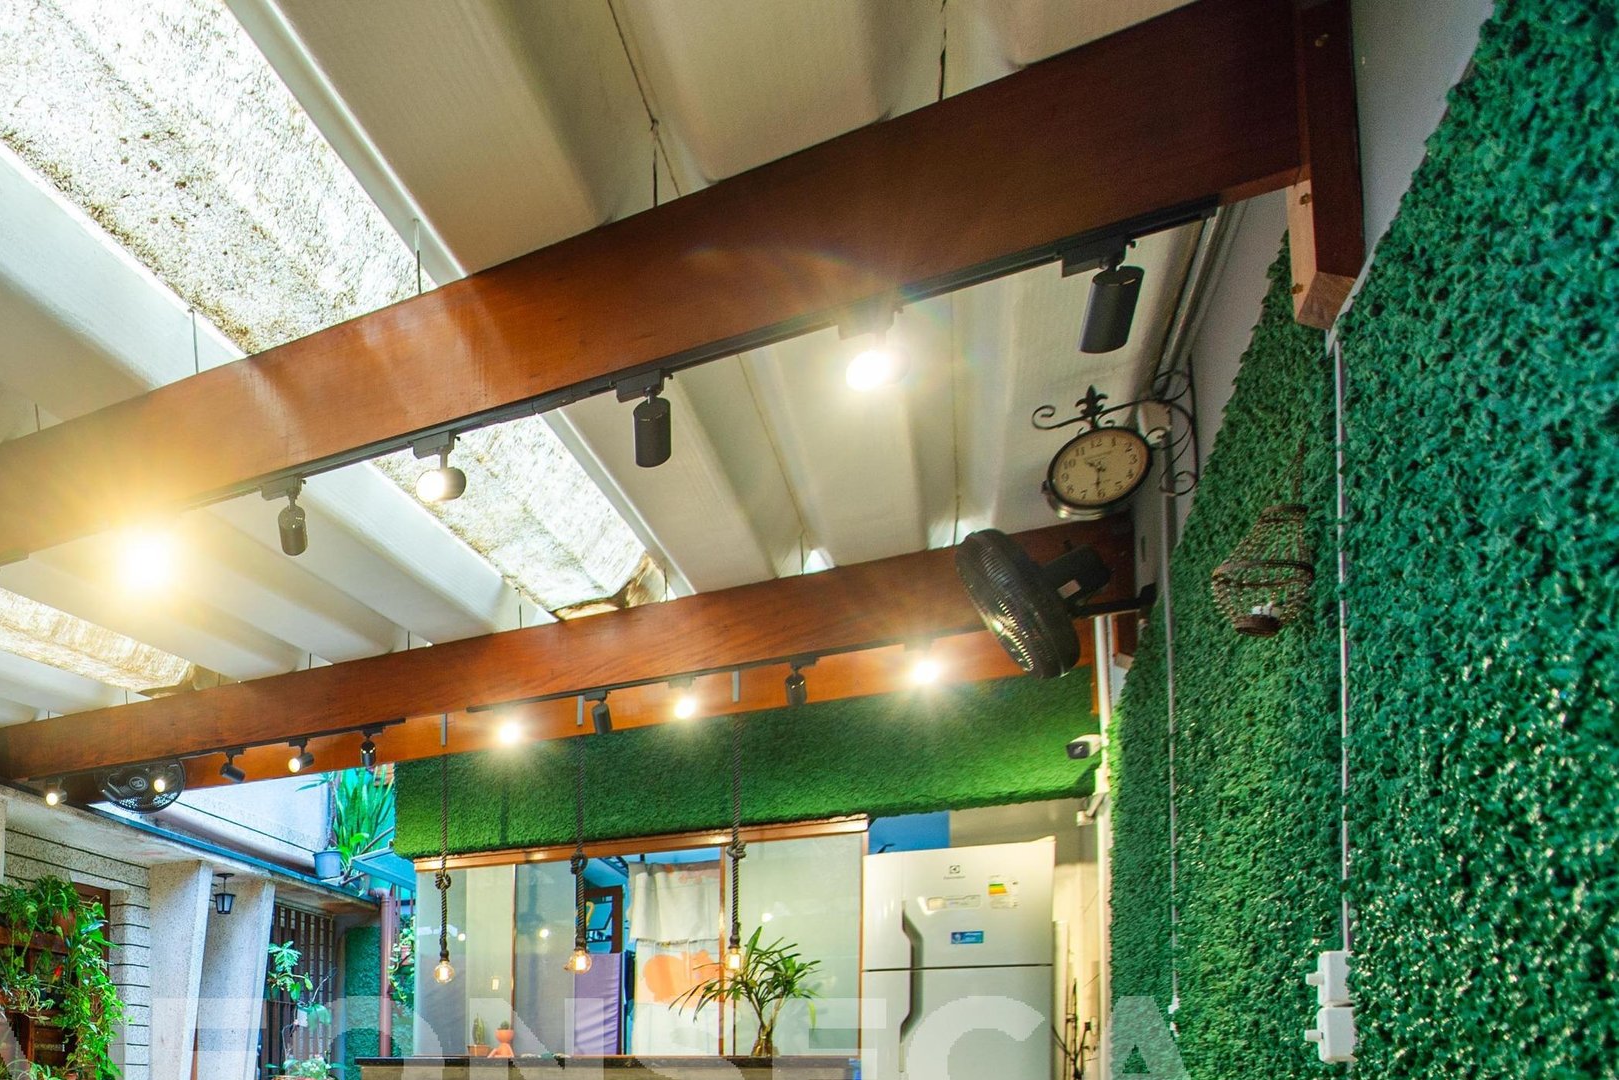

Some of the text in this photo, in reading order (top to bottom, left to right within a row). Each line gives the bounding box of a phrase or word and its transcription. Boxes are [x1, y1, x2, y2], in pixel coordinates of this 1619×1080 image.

[1090, 438, 1103, 449] 12
[1125, 442, 1133, 453] 2
[1075, 447, 1085, 457] 11
[1063, 459, 1077, 470] 10
[1129, 454, 1138, 465] 3
[1114, 481, 1123, 491] 5
[1080, 488, 1088, 499] 7
